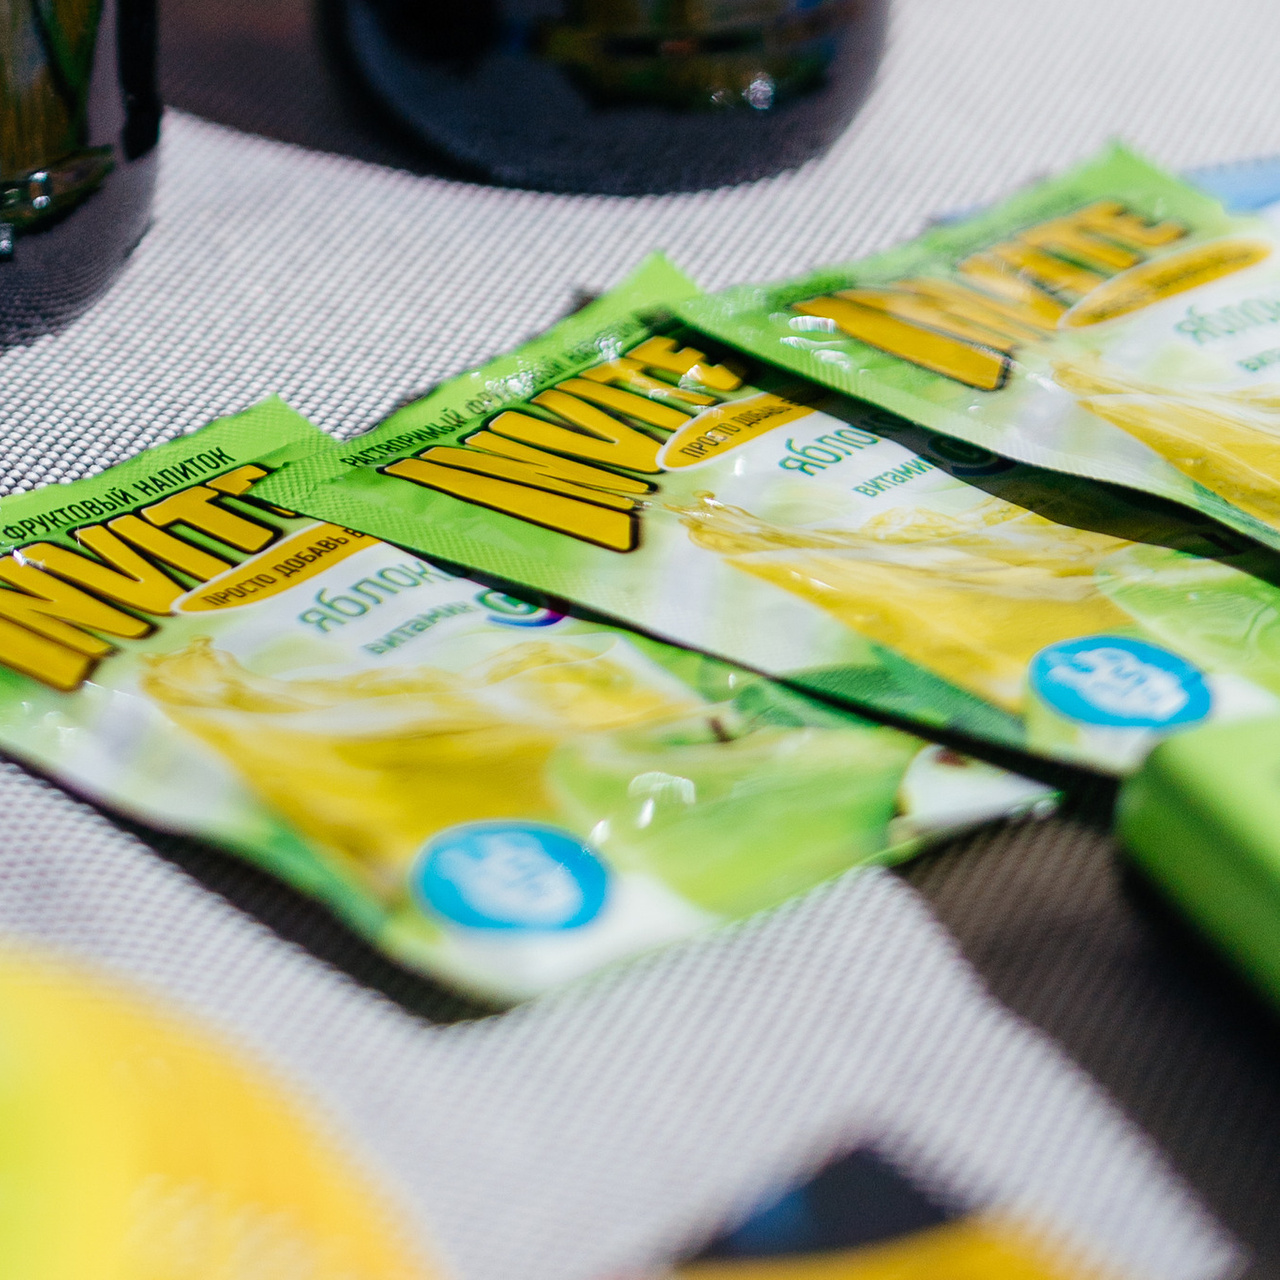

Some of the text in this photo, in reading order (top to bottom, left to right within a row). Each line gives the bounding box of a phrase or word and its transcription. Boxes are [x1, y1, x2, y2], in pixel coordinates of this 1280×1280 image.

[338, 406, 468, 469] РАСТВОРИМЫЙ
[375, 333, 747, 554] INVITE
[1, 486, 139, 543] ФРУКТОВЫЙ
[131, 446, 237, 497] НАПИТОК
[200, 572, 278, 607] ПРОСТО
[271, 534, 351, 579] ДОБАВЬ
